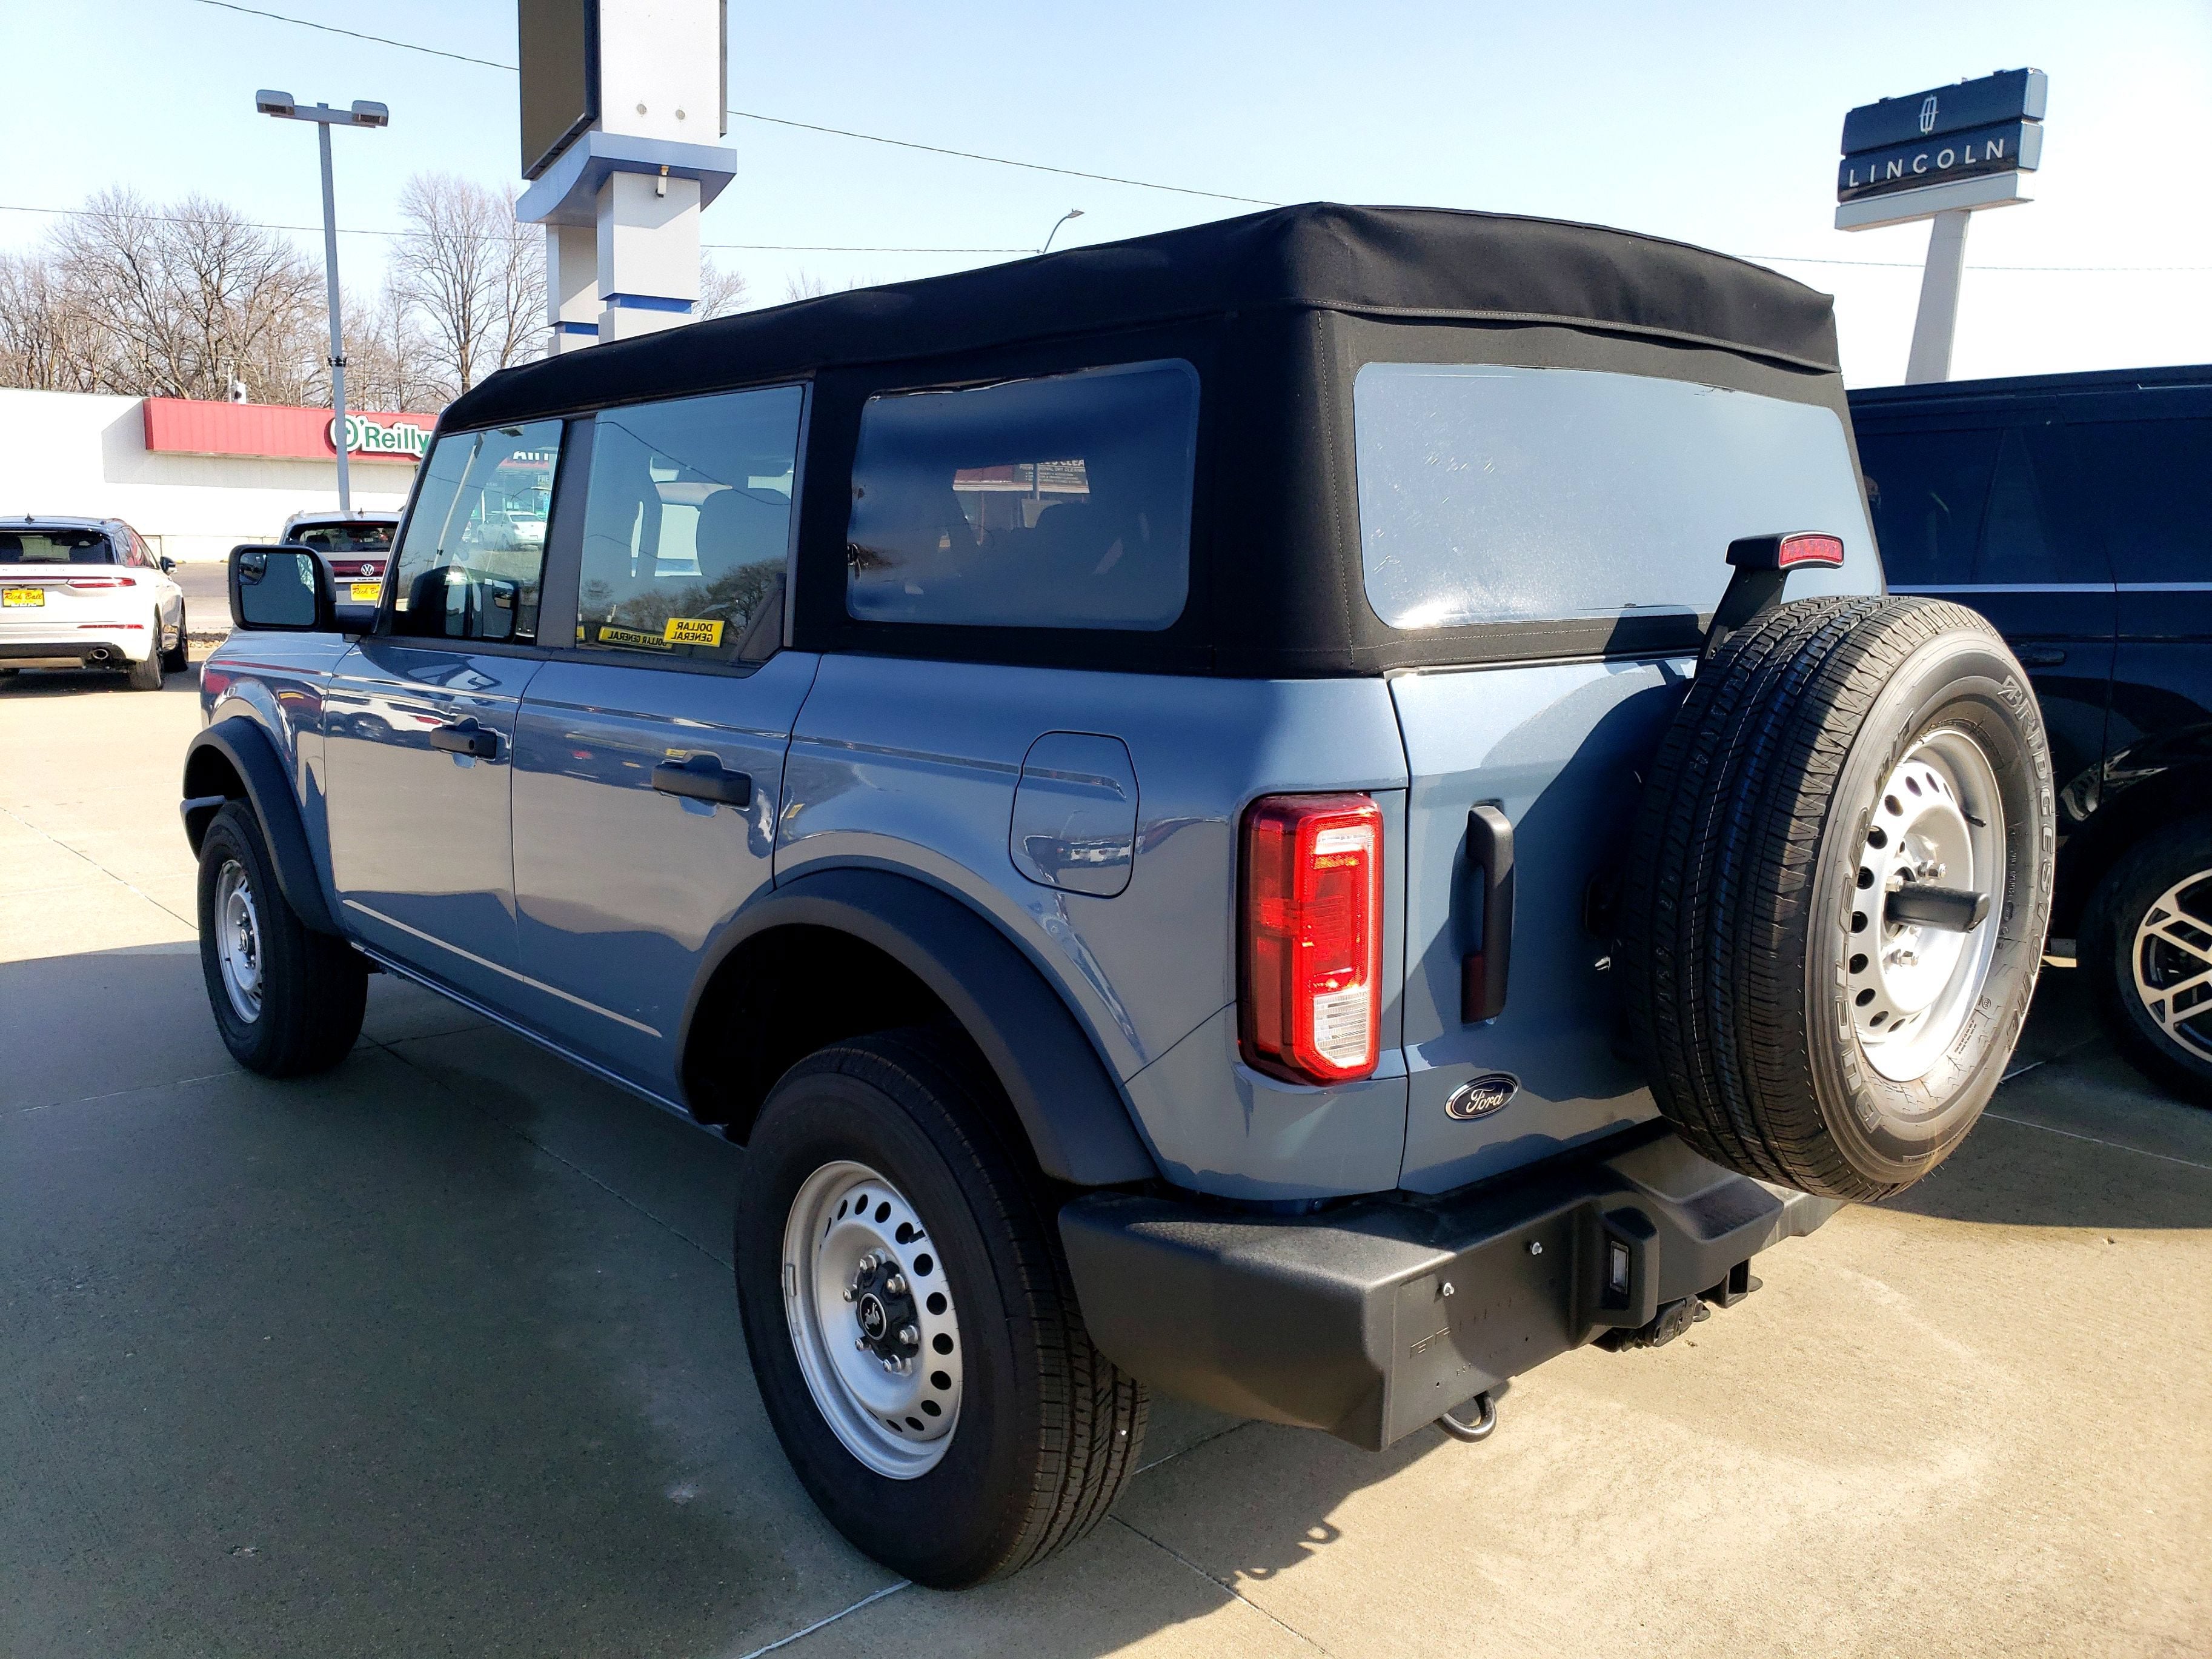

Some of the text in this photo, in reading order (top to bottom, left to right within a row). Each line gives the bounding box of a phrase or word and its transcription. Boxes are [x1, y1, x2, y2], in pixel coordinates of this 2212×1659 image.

[1849, 138, 2005, 188] LINCOLN
[336, 417, 431, 454] O'Reilly
[1466, 1086, 1504, 1113] Ford
